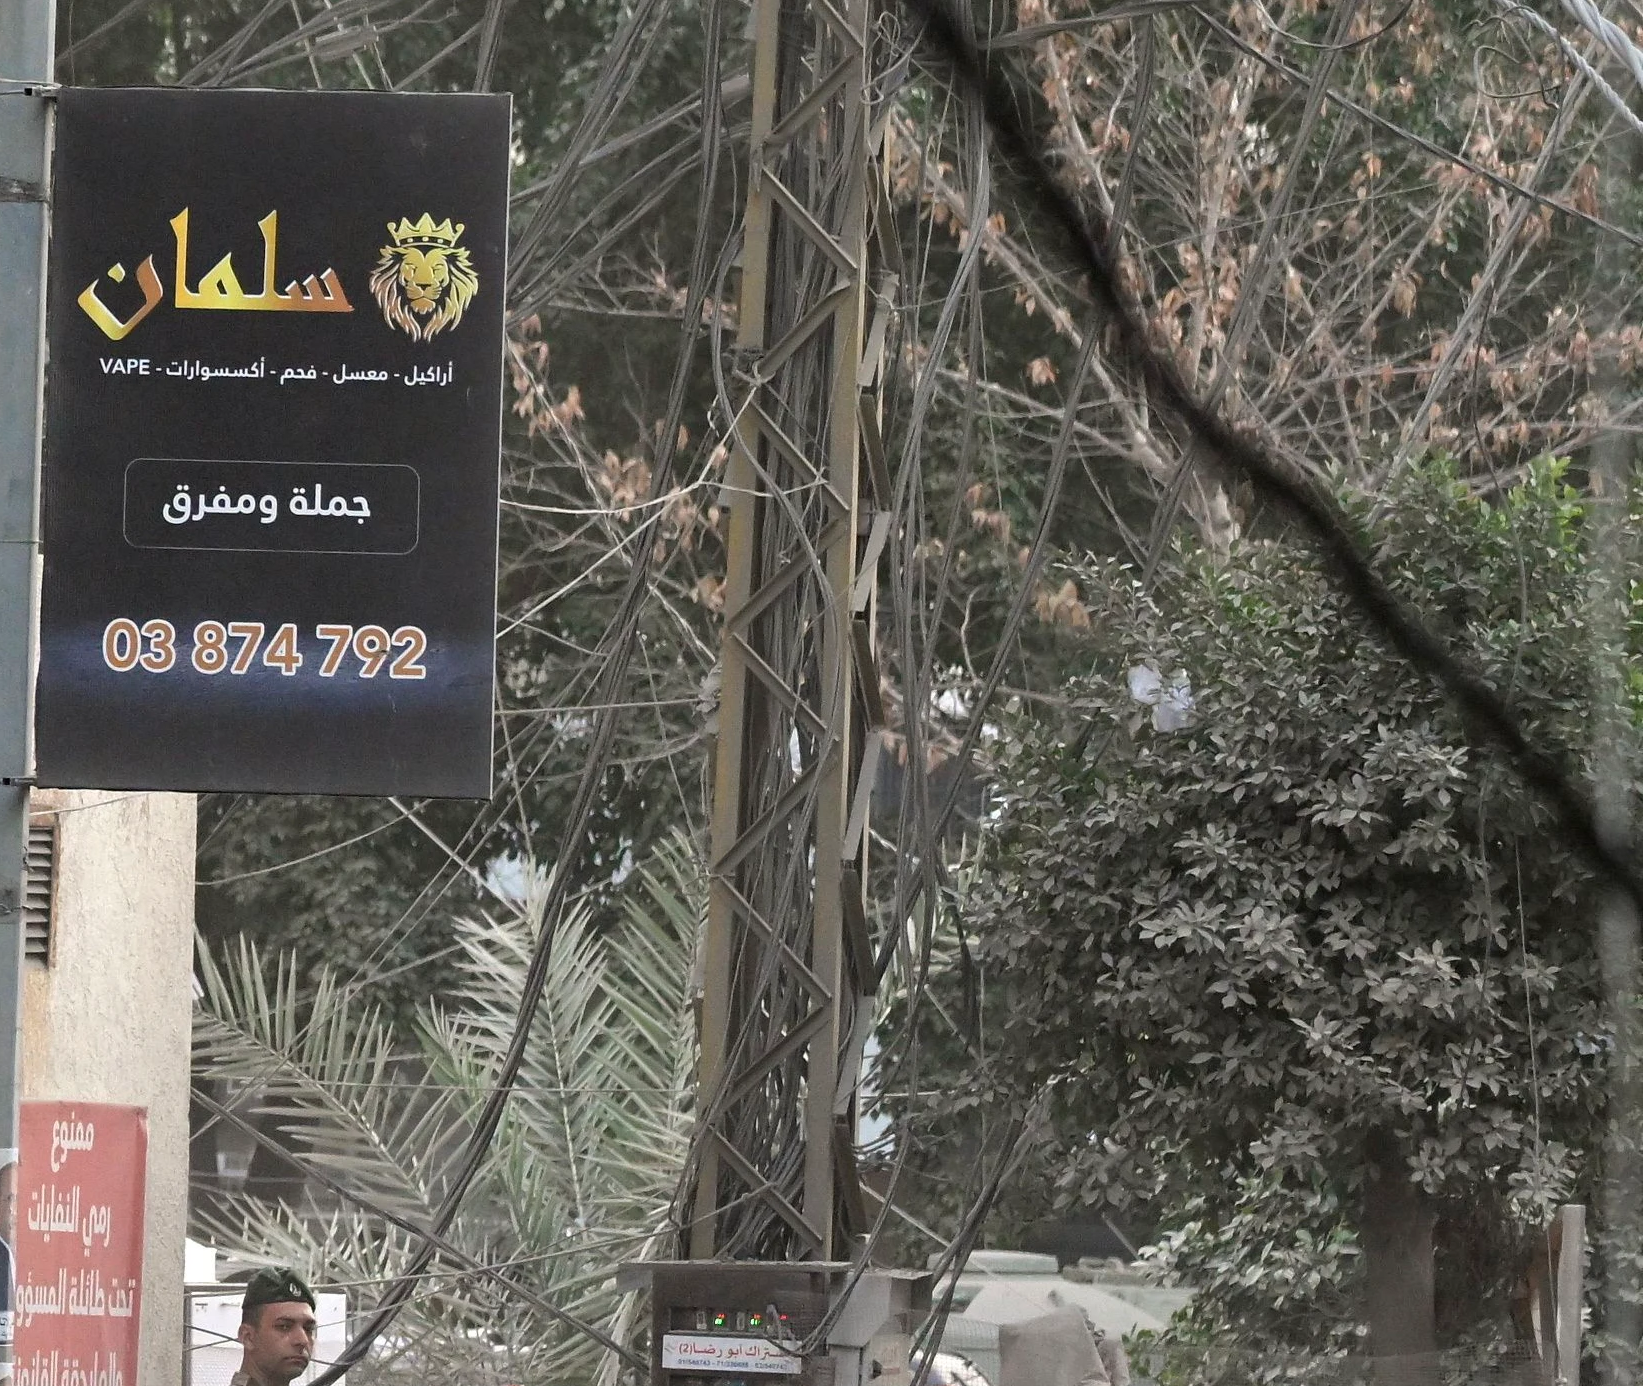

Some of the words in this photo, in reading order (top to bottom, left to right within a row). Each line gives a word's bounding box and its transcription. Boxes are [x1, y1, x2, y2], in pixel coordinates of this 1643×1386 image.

[77, 206, 355, 341] سلمان
[100, 358, 151, 376] VAPE
[166, 357, 265, 380] أكسسوارات
[280, 365, 317, 385] فحم
[332, 364, 389, 384] معسل
[404, 361, 453, 386] أراكيل
[162, 484, 278, 524] ومفرق
[289, 484, 371, 524] جملة
[102, 617, 177, 674] 03
[192, 621, 303, 677] 874
[316, 625, 428, 680] 792
[50, 1112, 95, 1173] ممنوع
[27, 1183, 81, 1243] النفايات
[82, 1198, 112, 1258] رمي
[15, 1268, 67, 1328] المسؤو
[69, 1268, 105, 1318] طائلة
[108, 1275, 135, 1318] تحت
